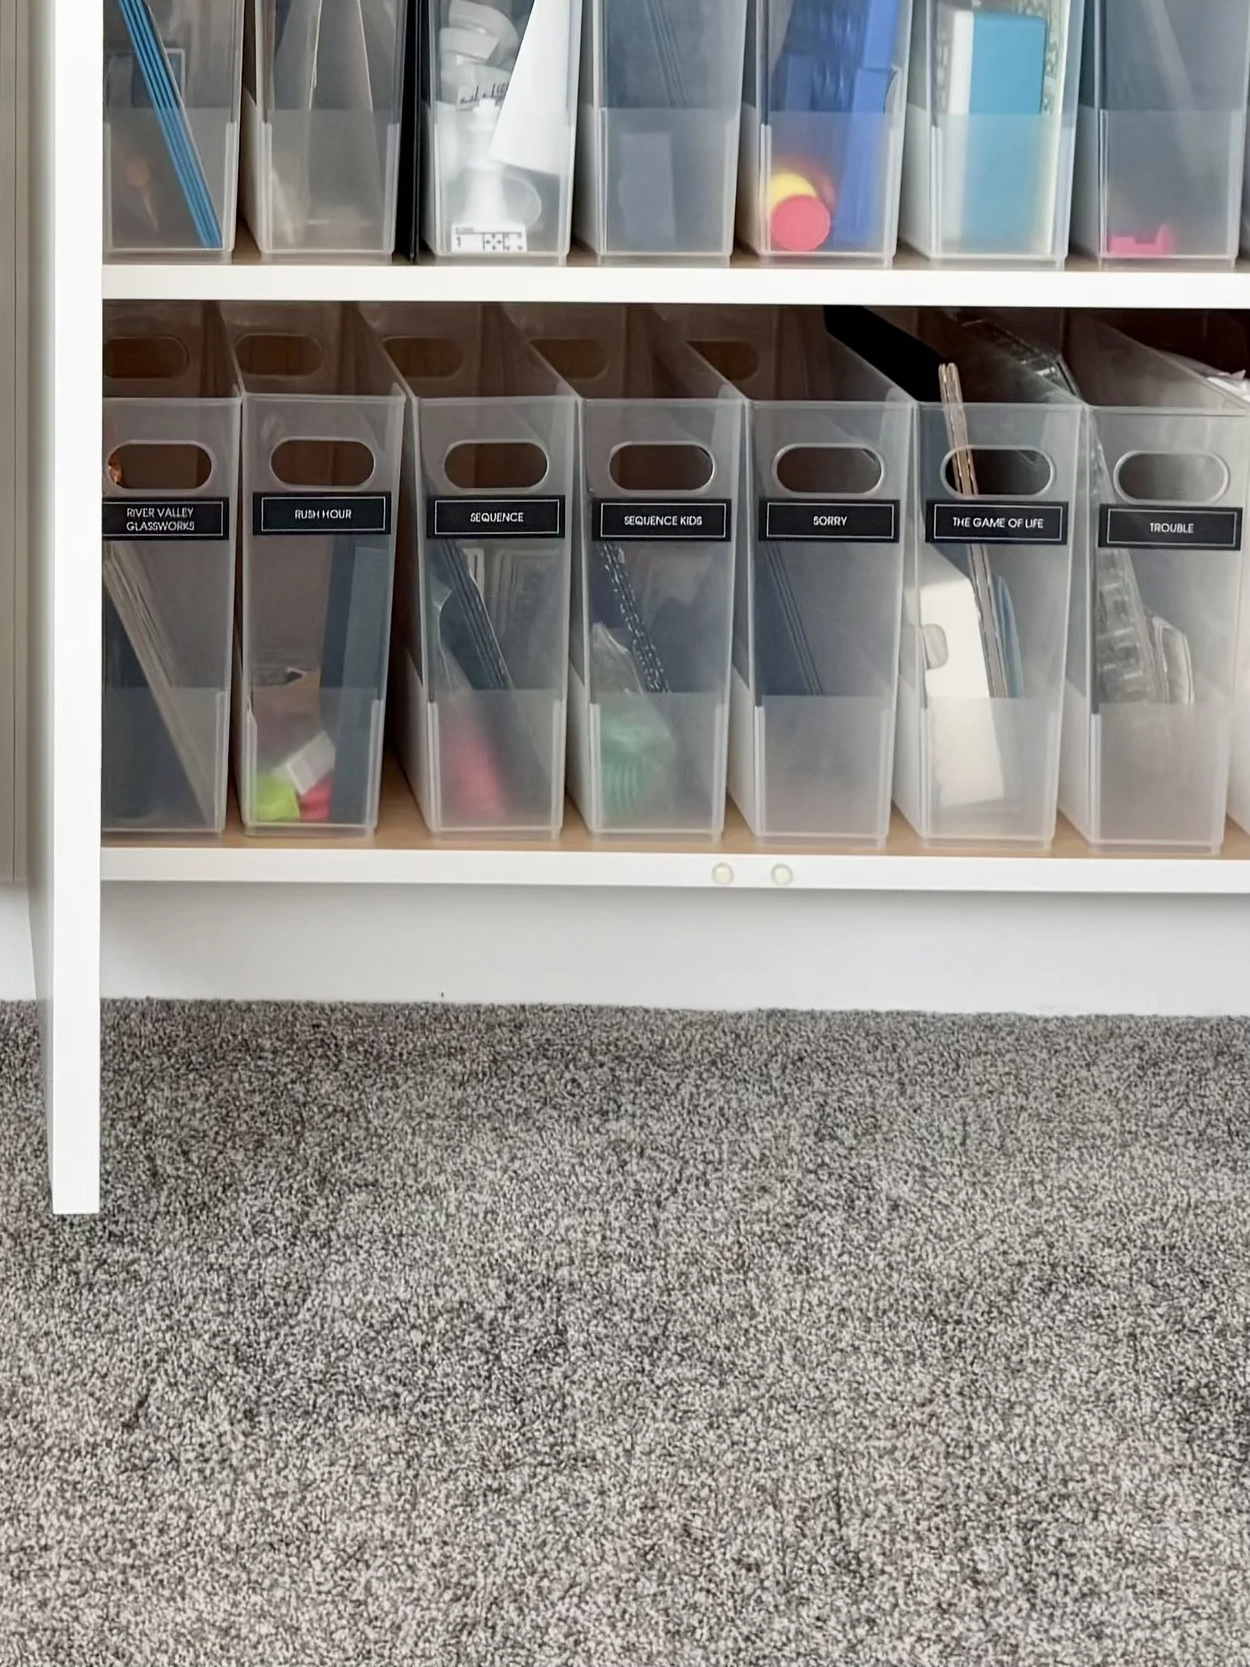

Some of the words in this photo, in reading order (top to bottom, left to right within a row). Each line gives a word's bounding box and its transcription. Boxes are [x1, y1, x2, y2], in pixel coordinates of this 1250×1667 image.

[126, 507, 155, 519] RIVER
[156, 507, 194, 518] VALLEY
[294, 508, 320, 520] RUSH
[322, 508, 352, 520] HOUR
[470, 511, 524, 523] SEQUENCE
[126, 520, 195, 532] GLASSWORKS
[624, 515, 678, 527] SEQUENCE
[679, 515, 703, 526] KIDS
[813, 515, 848, 527] SORRY
[952, 516, 971, 528] THE
[972, 516, 1006, 529] GAME
[1007, 517, 1024, 529] OF
[1024, 517, 1044, 529] LIFE
[1149, 522, 1194, 534] TROUBLE
